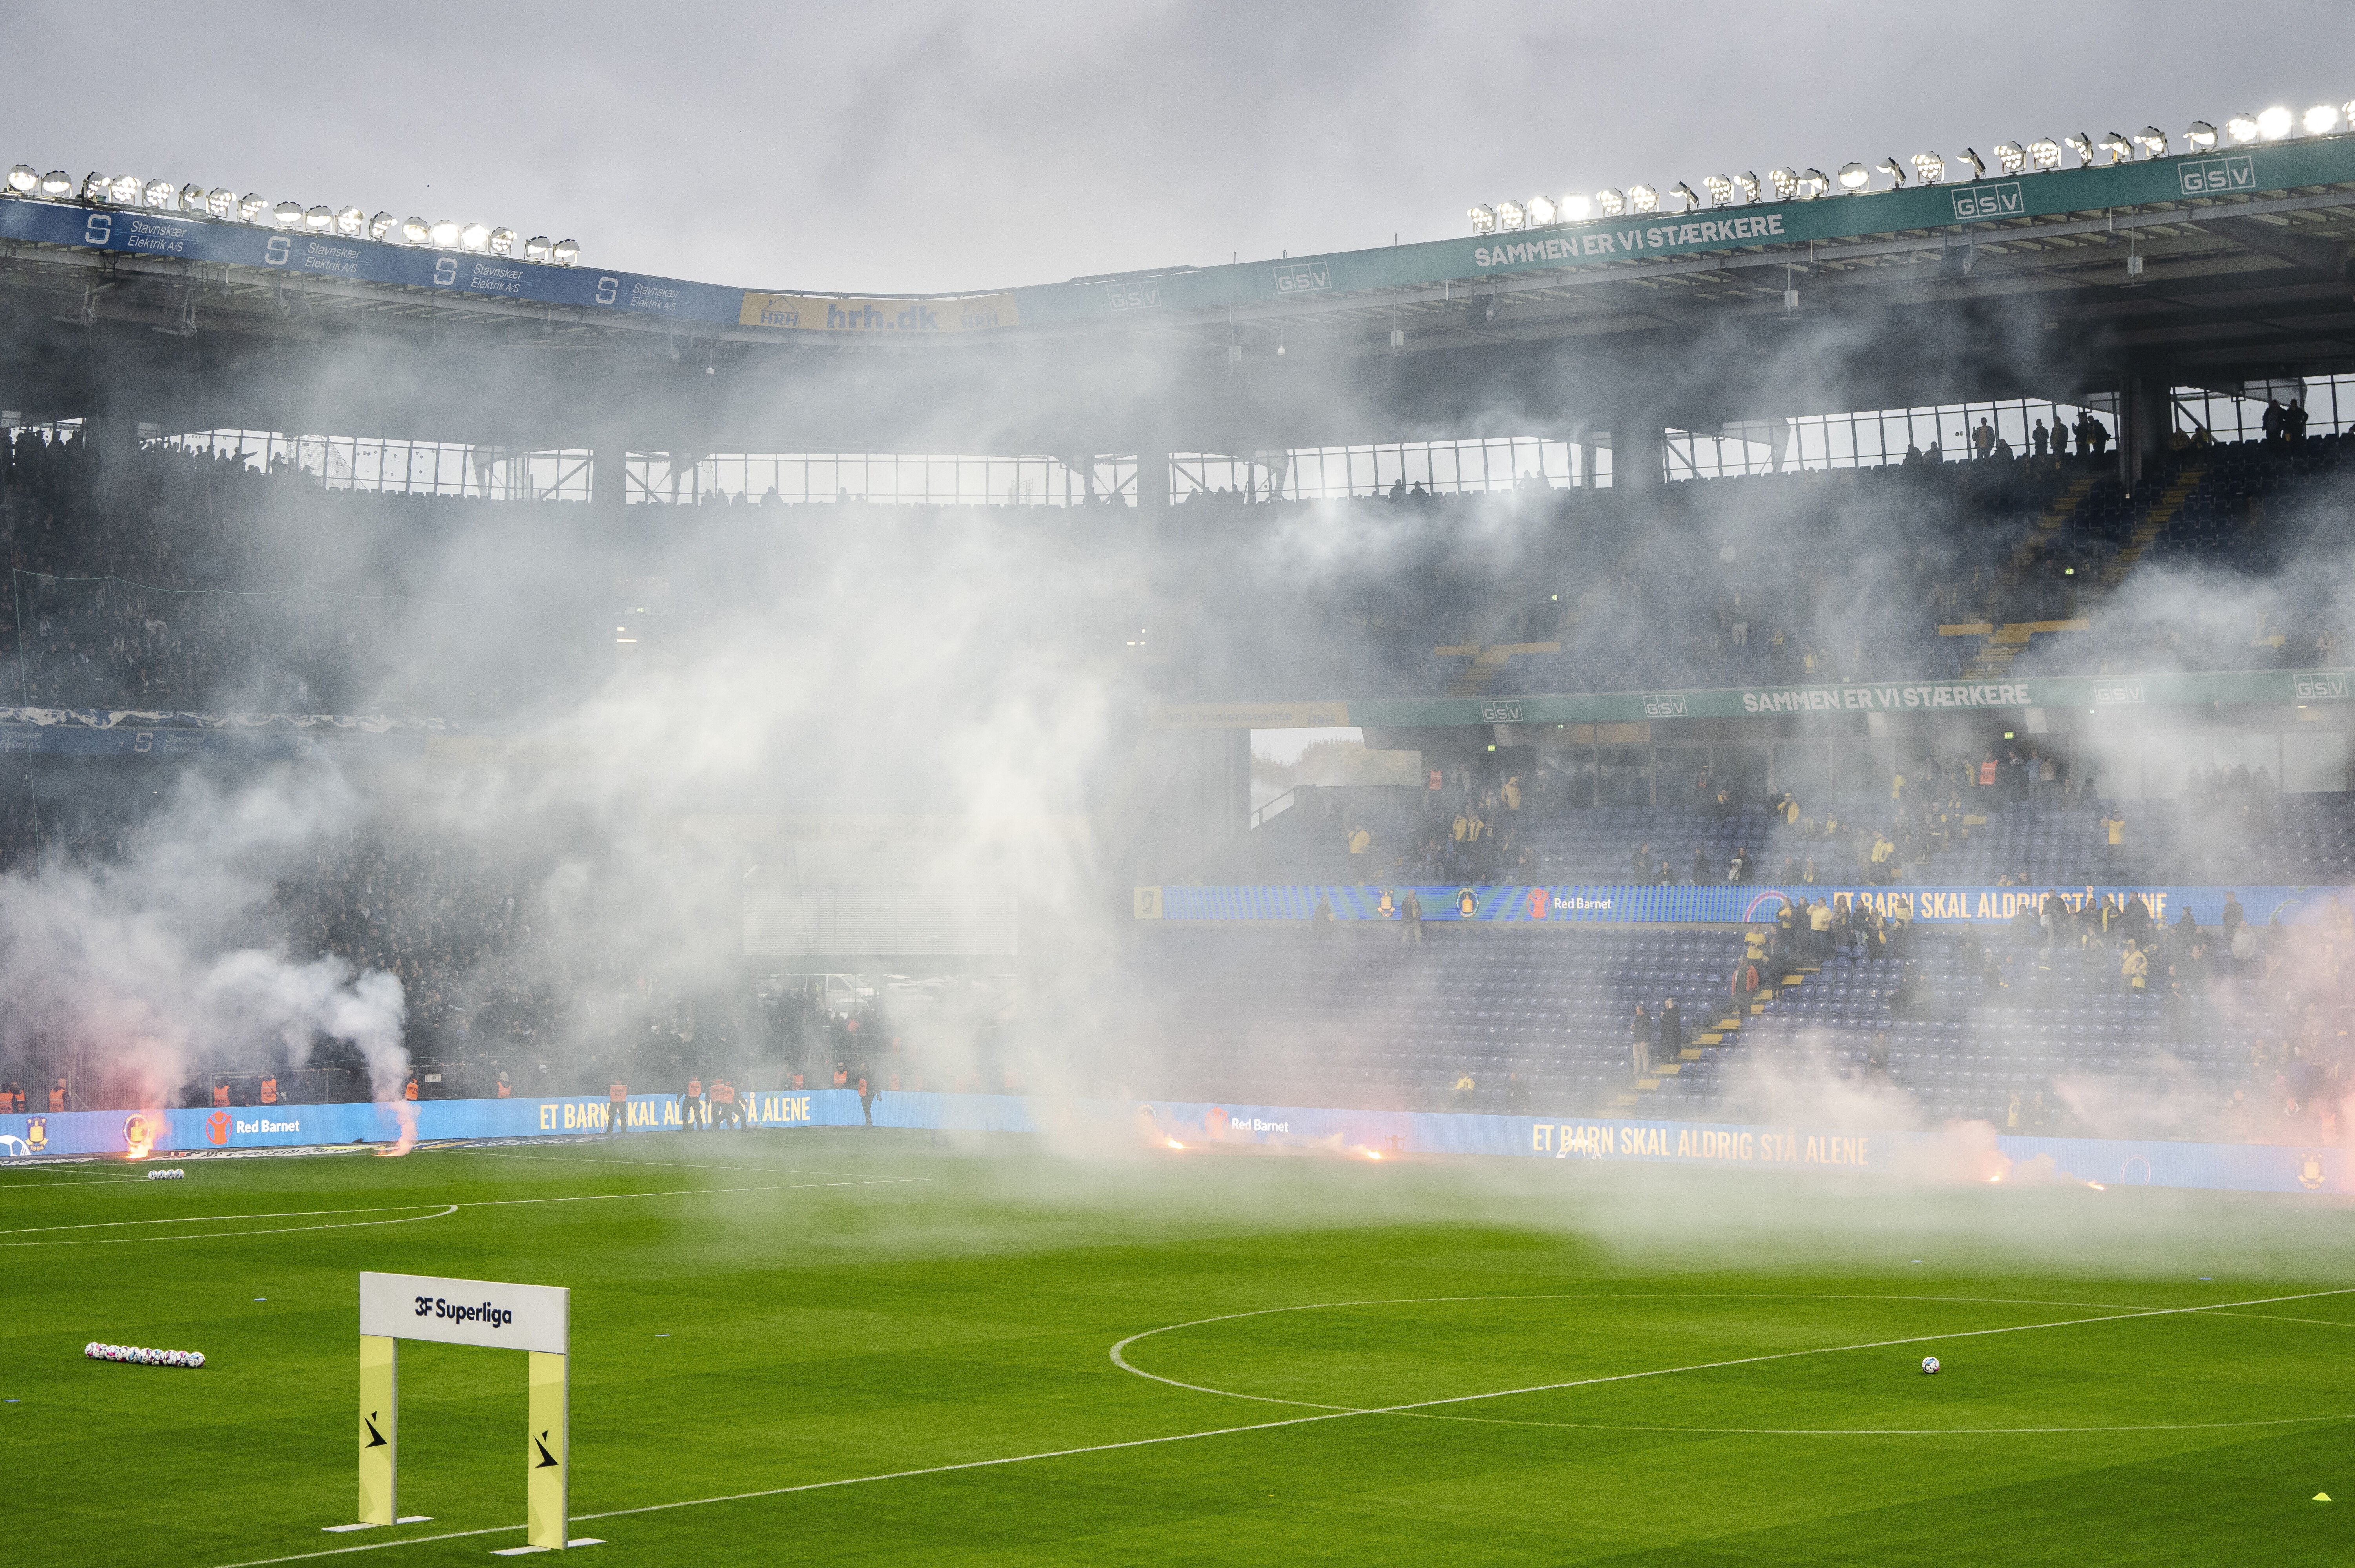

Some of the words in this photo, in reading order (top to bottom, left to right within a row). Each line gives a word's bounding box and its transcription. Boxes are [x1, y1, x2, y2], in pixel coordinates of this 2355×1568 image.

[2184, 168, 2248, 190] GSV
[1957, 193, 2017, 215] GSV
[131, 221, 186, 237] Stavnskær
[128, 235, 165, 250] Elektrik
[166, 239, 184, 252] A/S
[1475, 237, 1579, 267] SAMMEN
[1584, 233, 1616, 255] ER
[1616, 231, 1643, 251] VI
[1647, 214, 1785, 248] STÆRKERE
[307, 242, 361, 259] Stavnskær
[305, 257, 340, 271] Elektrik
[341, 261, 358, 273] A/S
[473, 263, 523, 280] Stavnskær
[471, 277, 504, 292] Elektrik
[504, 282, 520, 292] A/S
[1278, 272, 1326, 290] GSV
[633, 283, 680, 298] Stavnskær
[630, 297, 662, 310] Elektrik
[662, 301, 677, 311] A/S
[1111, 290, 1157, 308] GSV
[760, 312, 798, 326] HRH
[827, 304, 938, 330] hrh.dk
[962, 314, 998, 329] HRH
[2098, 687, 2140, 701] GSV
[2298, 682, 2344, 696] GSV
[1743, 690, 1840, 713] SAMMEN
[1844, 689, 1875, 709] ER
[1876, 688, 1900, 708] VI
[1903, 684, 2031, 708] STÆRKERE
[1484, 708, 1519, 720] GSV
[1647, 702, 1684, 716] GSV
[1307, 715, 1335, 725] HRH
[166, 734, 206, 744] Stavnskær
[163, 744, 190, 753] Elektrik
[1554, 897, 1574, 909] Red
[1577, 897, 1612, 909] Barnet
[1921, 892, 1971, 919] SKAL
[540, 1104, 559, 1129] ET
[564, 1103, 610, 1129] BARN
[763, 1096, 810, 1123] ALENE
[236, 1120, 259, 1134] Red
[261, 1119, 300, 1133] Barnet
[1232, 1118, 1251, 1131] Red
[1254, 1119, 1288, 1132] Barnet
[1533, 1124, 1554, 1151] ET
[1561, 1125, 1614, 1154] BARN
[1621, 1127, 1670, 1156] SKAL
[1678, 1129, 1753, 1160] ALDRIG
[1761, 1127, 1797, 1162] STÅ
[1805, 1136, 1868, 1165] ALENE
[415, 1296, 433, 1316] 3F
[436, 1299, 512, 1328] Superliga
